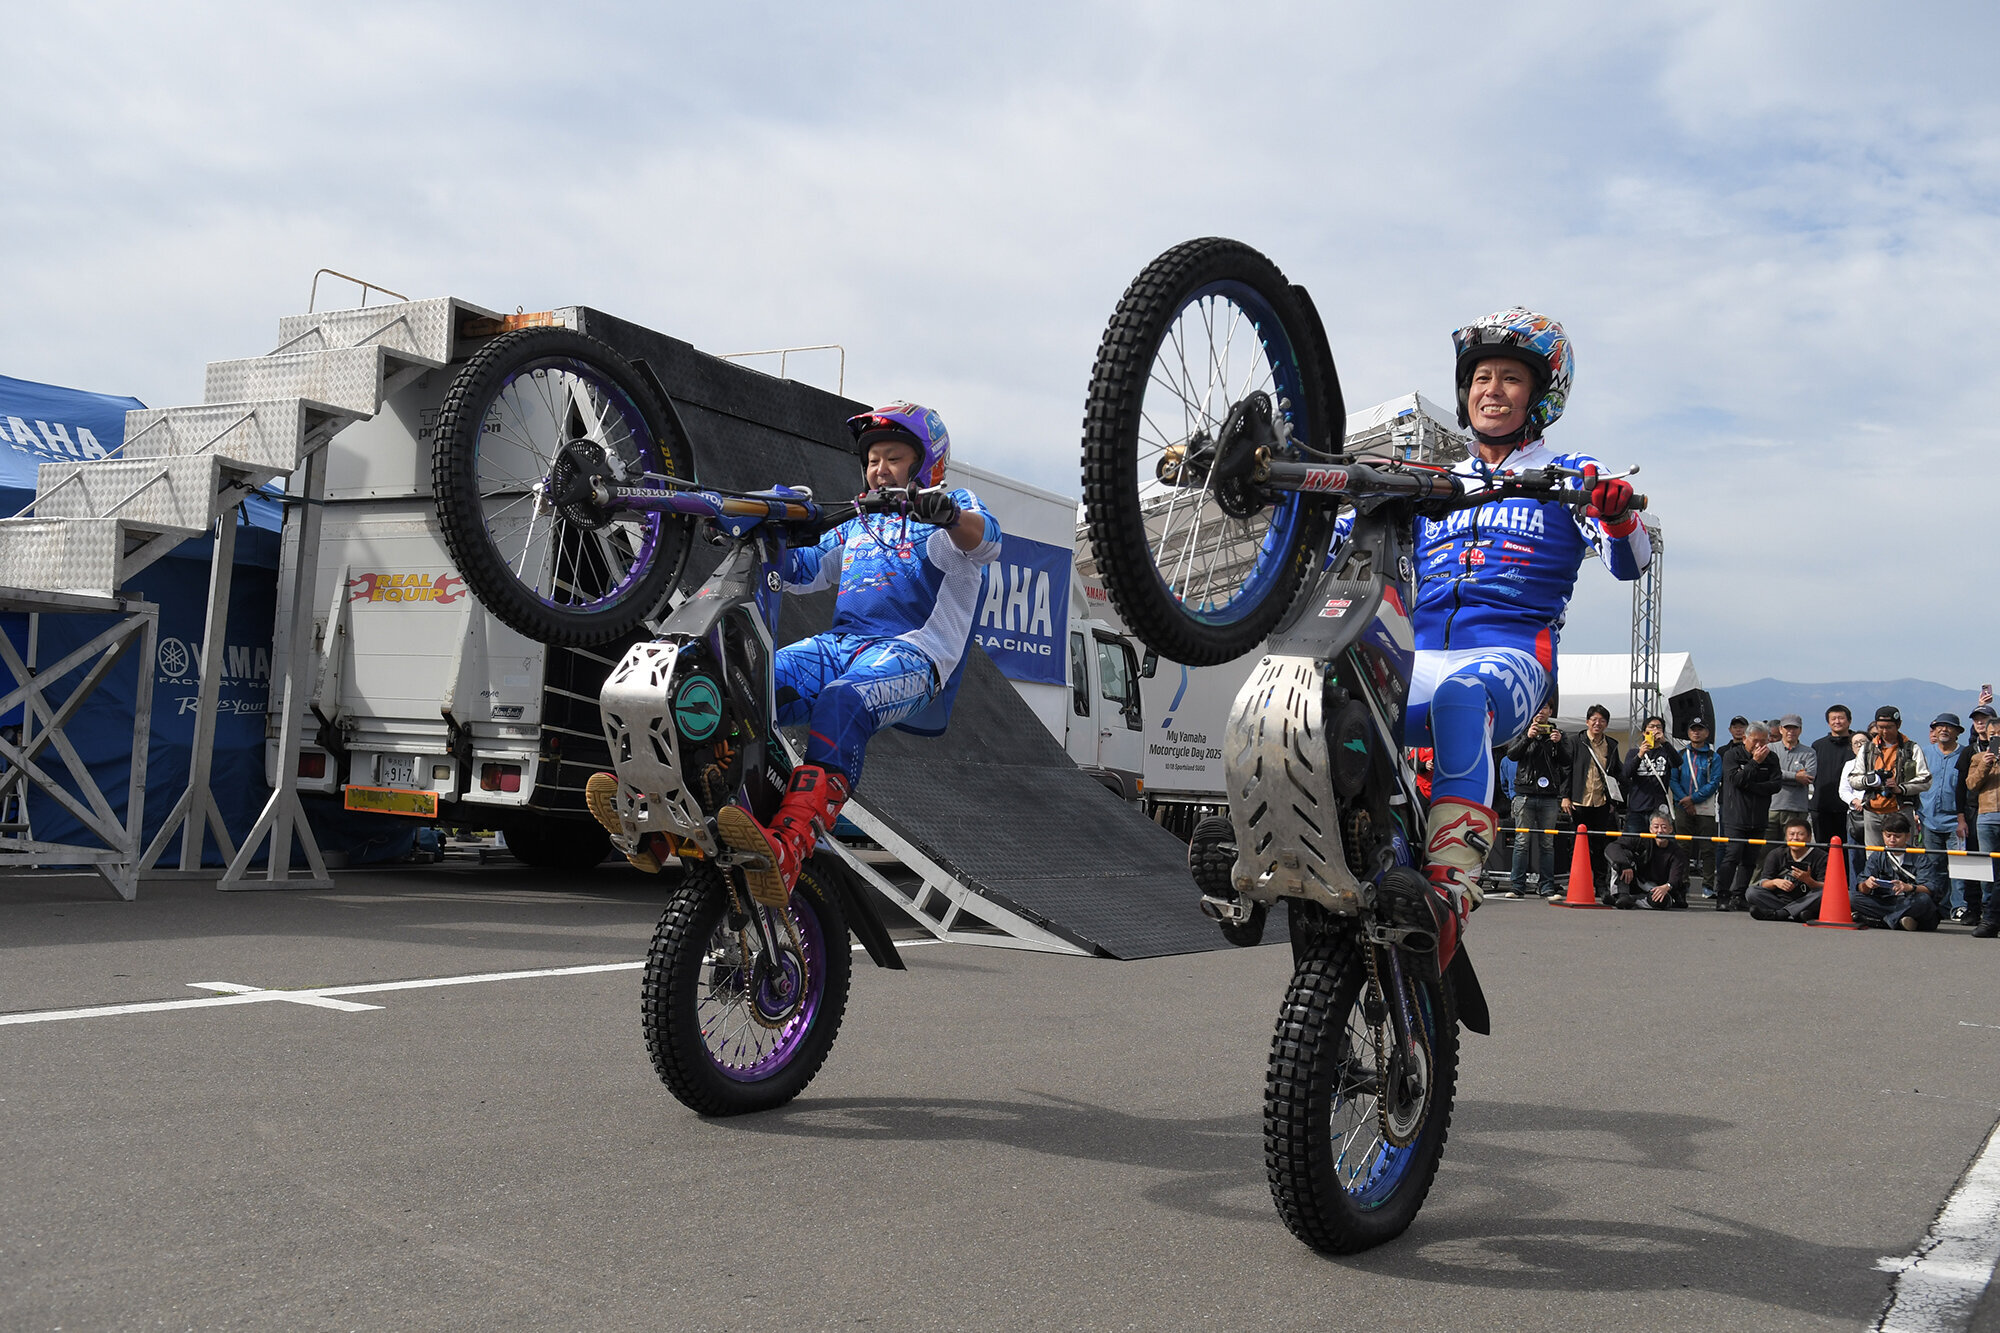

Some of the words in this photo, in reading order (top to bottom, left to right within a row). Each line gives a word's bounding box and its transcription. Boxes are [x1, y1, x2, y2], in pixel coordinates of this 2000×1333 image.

[1299, 469, 1348, 490] KYB
[617, 487, 677, 498] DUNLOP
[1446, 507, 1545, 533] YAMAHA
[1505, 542, 1532, 552] MOTUL
[375, 574, 433, 588] REAL
[372, 588, 445, 602] EQUIP
[975, 634, 1052, 656] RACING
[1166, 730, 1179, 744] My
[1180, 731, 1207, 744] Yamaha
[1149, 744, 1190, 758] Motorcycle
[1191, 747, 1205, 760] Day
[1206, 748, 1222, 759] 2025
